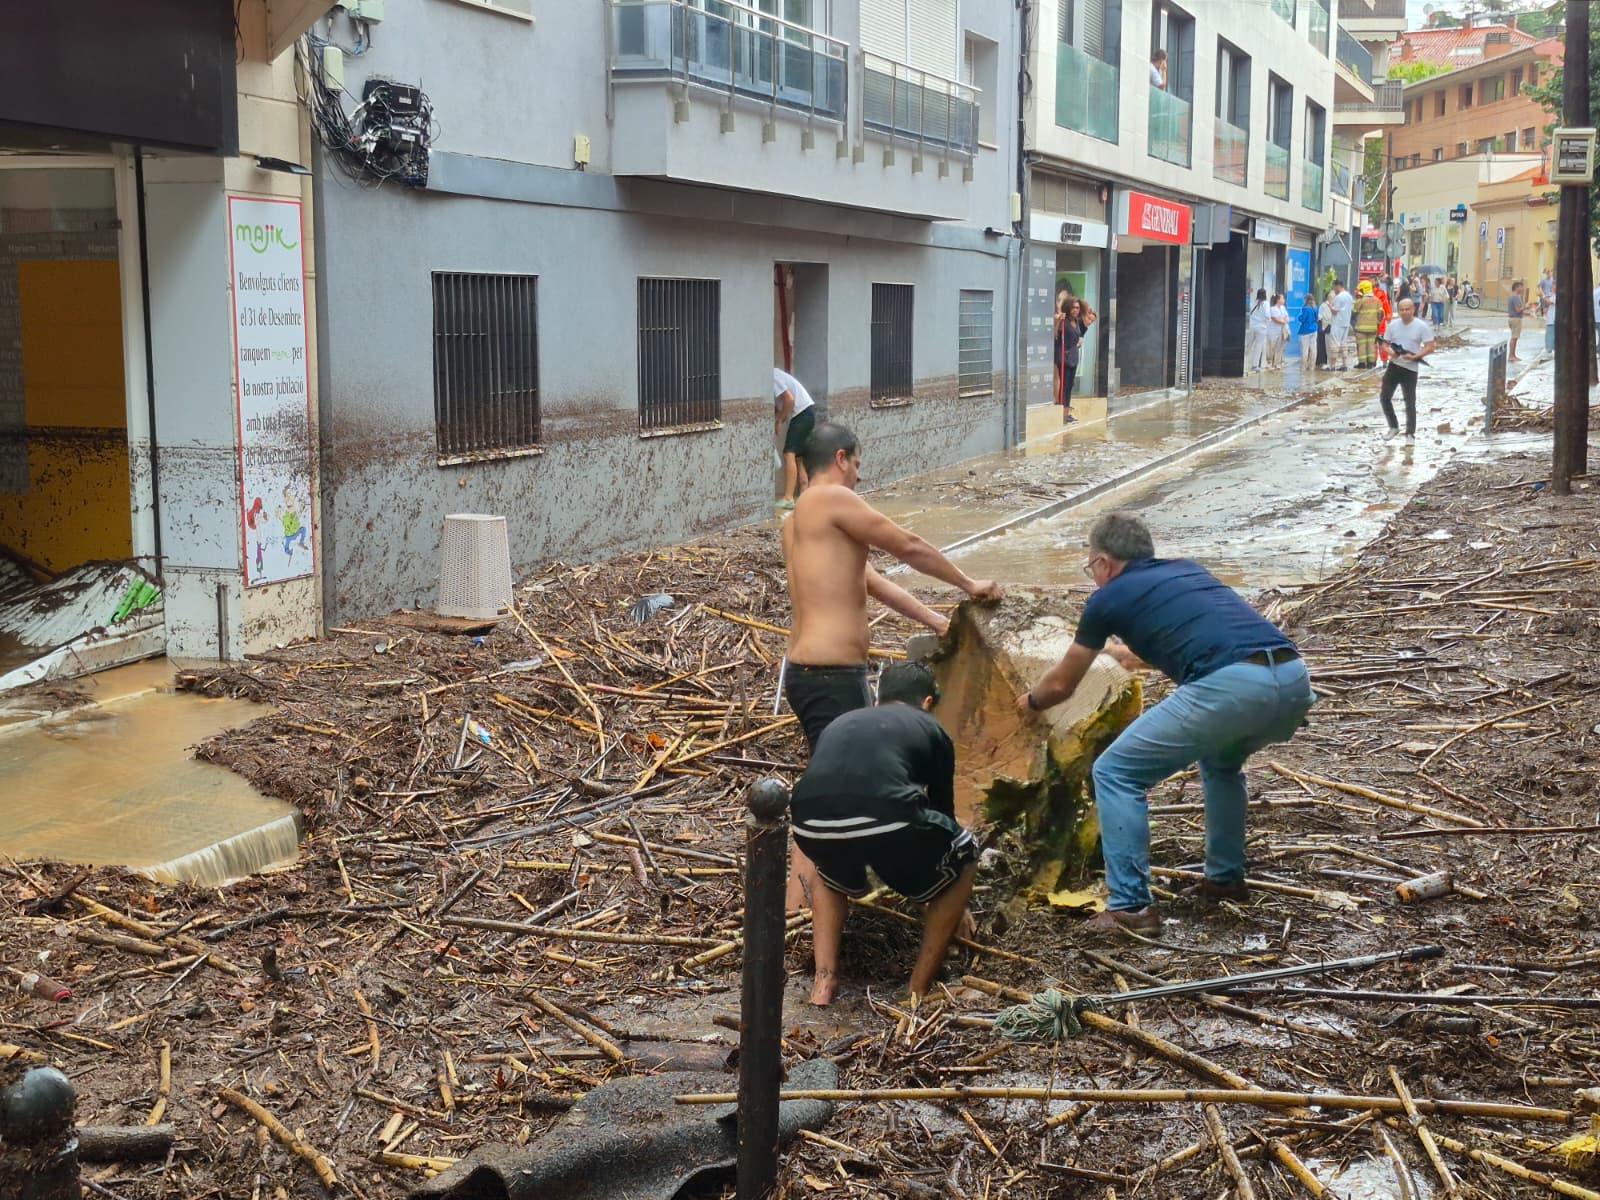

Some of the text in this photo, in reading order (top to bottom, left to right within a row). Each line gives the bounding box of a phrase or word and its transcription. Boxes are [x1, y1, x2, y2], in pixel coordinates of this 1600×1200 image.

[239, 271, 299, 296] Benvolguts clients
[240, 307, 301, 327] el 31 de Desembre
[240, 347, 271, 366] tanquem
[292, 346, 303, 364] per
[243, 376, 304, 400] la nostra jubilació
[246, 412, 261, 432] amb
